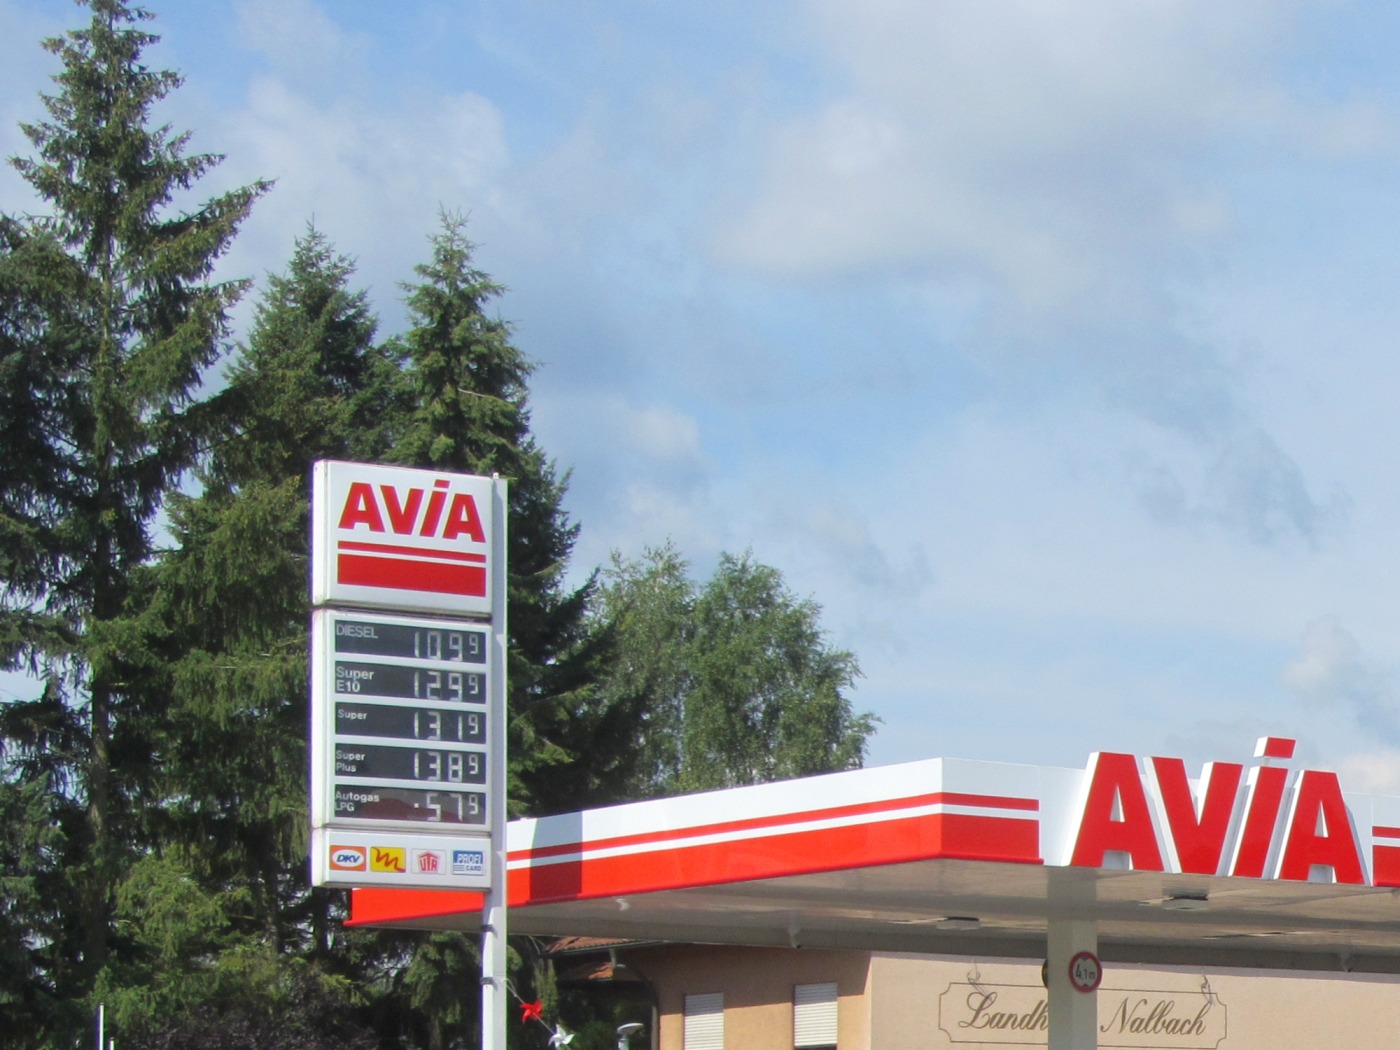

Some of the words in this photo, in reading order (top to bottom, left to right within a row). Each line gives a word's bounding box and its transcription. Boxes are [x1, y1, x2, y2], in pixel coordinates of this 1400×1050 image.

[336, 623, 379, 639] DIESEL
[336, 665, 375, 684] Super
[336, 680, 361, 693] E10
[337, 708, 368, 721] Super
[335, 749, 366, 762] Super
[335, 762, 357, 773] Plus
[335, 790, 380, 804] Autogas
[335, 801, 355, 812] LPG
[336, 853, 361, 863] DKV
[456, 853, 482, 865] PROFI
[958, 991, 1048, 1031] Landh
[1100, 996, 1213, 1036] Nalbach
